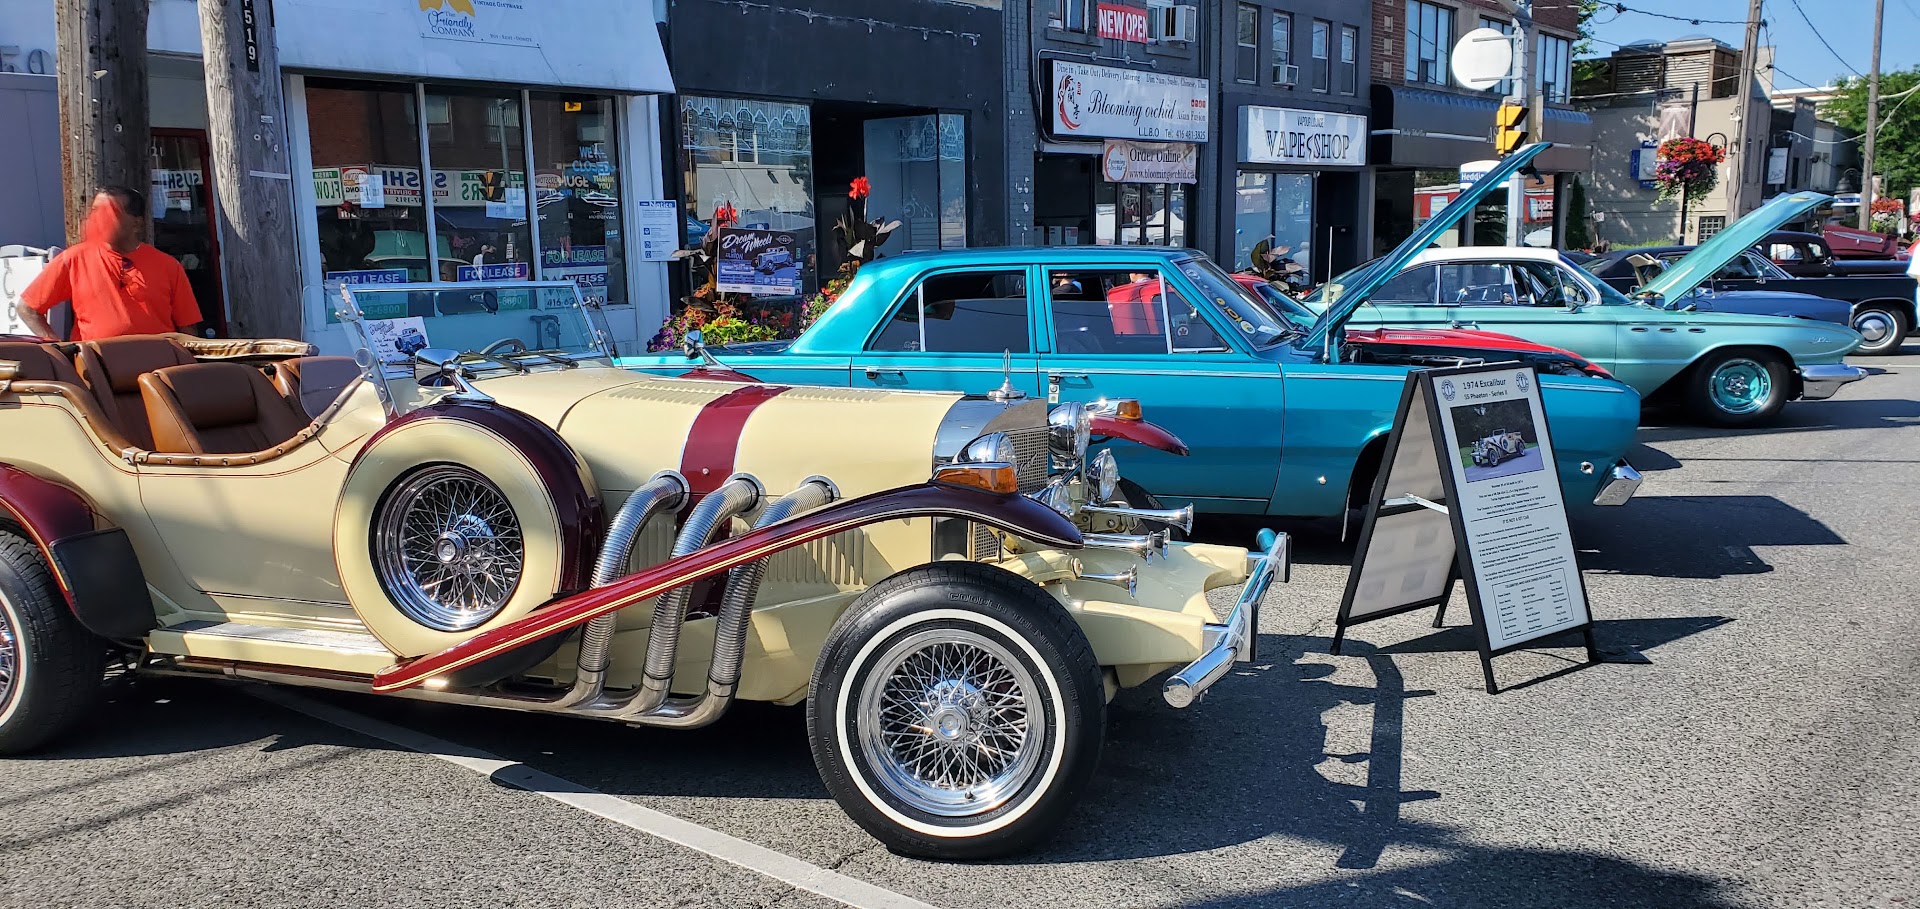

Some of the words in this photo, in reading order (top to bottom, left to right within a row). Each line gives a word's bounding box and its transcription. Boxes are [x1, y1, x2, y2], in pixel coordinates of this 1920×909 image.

[428, 11, 473, 31] Friendly
[1098, 9, 1124, 35] NEW
[1125, 12, 1148, 38] OPEN
[431, 26, 475, 37] COMPANY
[1087, 89, 1143, 126] Blooming
[1144, 98, 1177, 120] orchid
[1266, 130, 1306, 159] VAPE
[1313, 133, 1350, 160] SHOP
[1156, 151, 1182, 163] Online
[722, 233, 755, 248] Dream
[741, 234, 773, 253] Wheels
[546, 251, 570, 264] FOR
[571, 250, 605, 263] LEASE
[362, 273, 400, 284] LEASE
[465, 269, 487, 280] FOR
[488, 267, 521, 278] LEASE
[565, 274, 605, 283] WEISS
[1462, 381, 1479, 389] 1974
[1479, 379, 1506, 388] Excalibur
